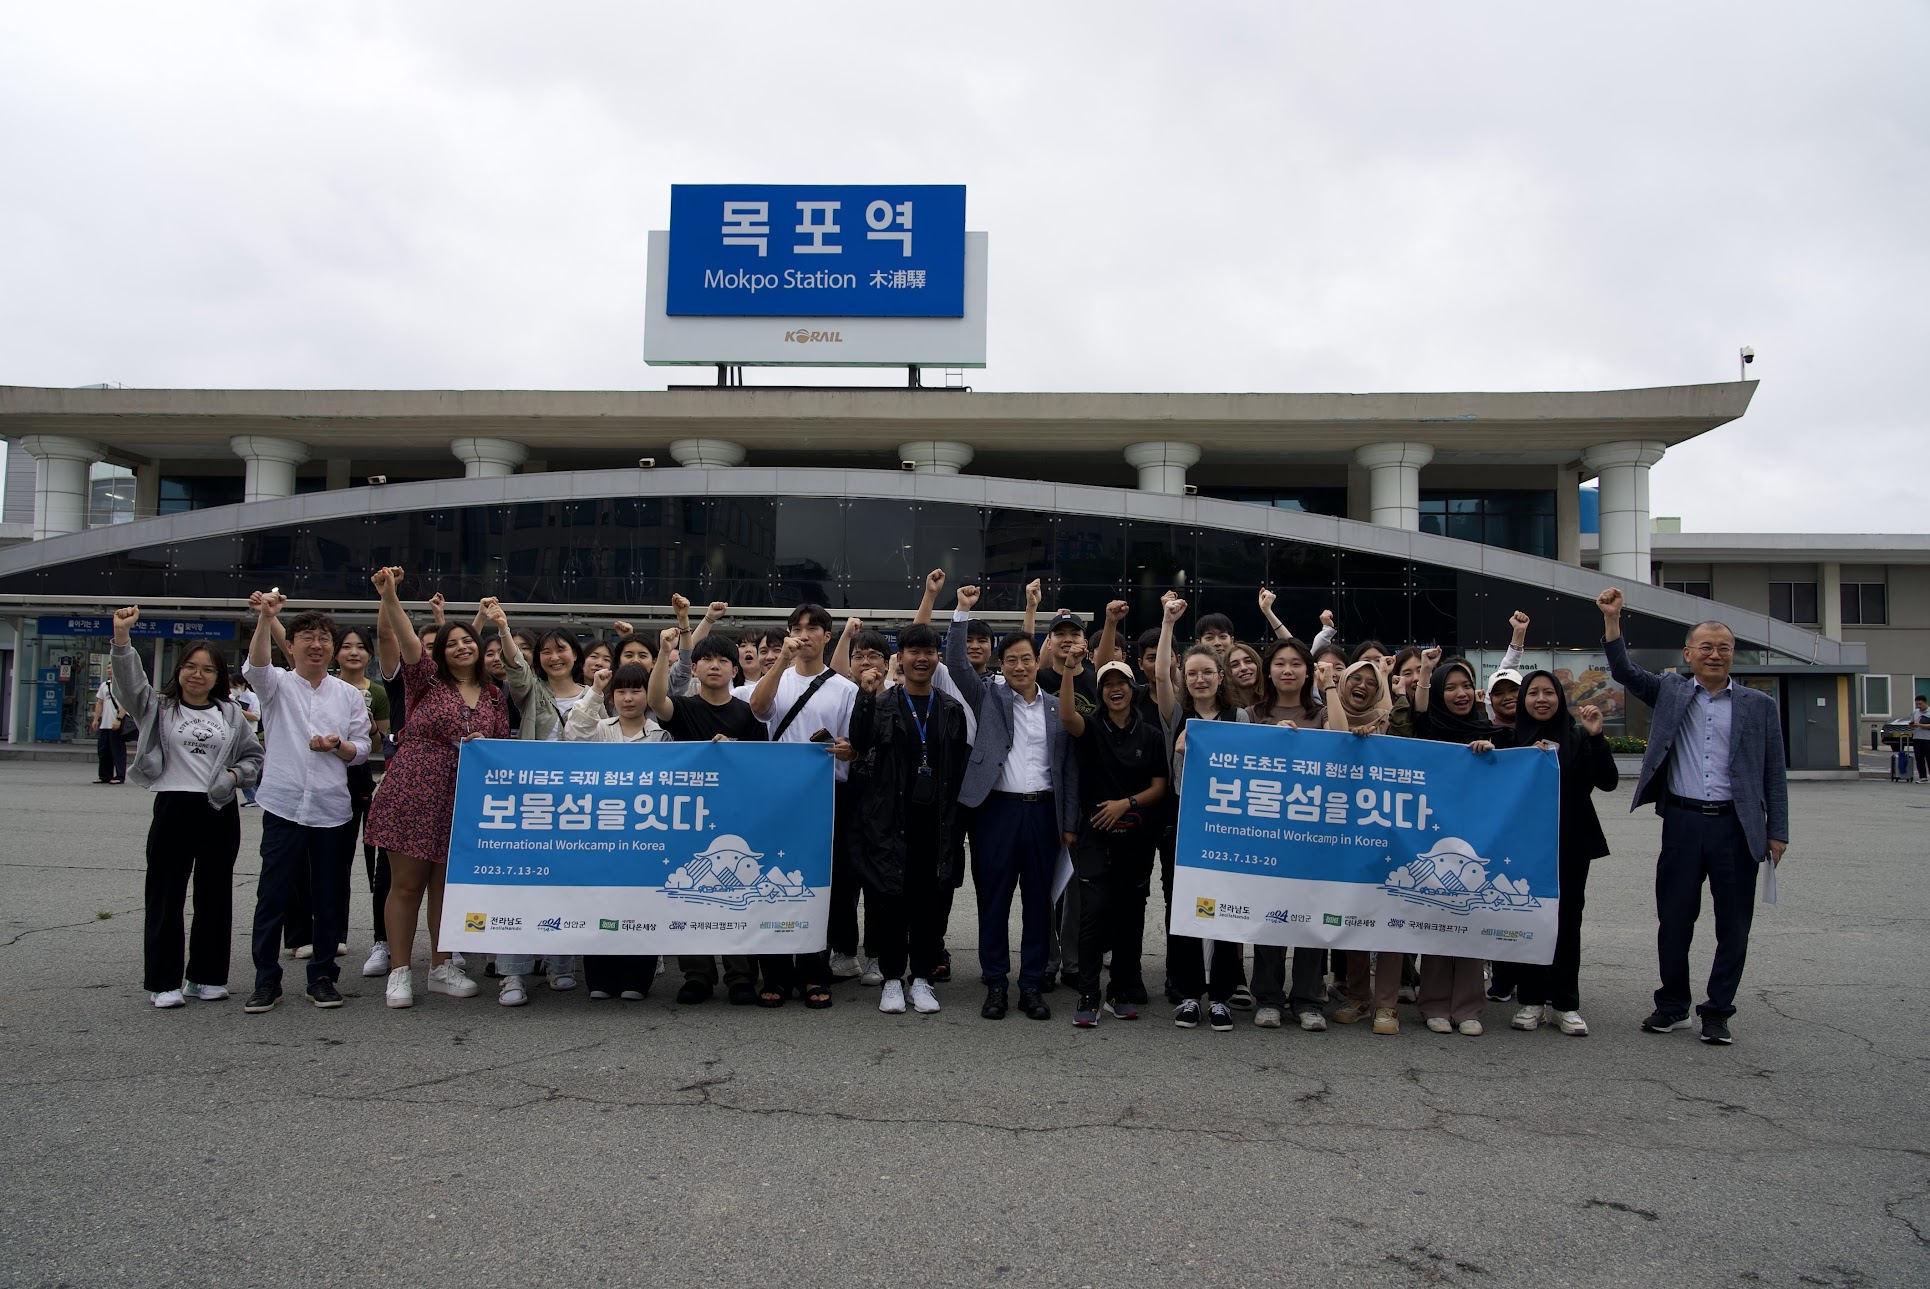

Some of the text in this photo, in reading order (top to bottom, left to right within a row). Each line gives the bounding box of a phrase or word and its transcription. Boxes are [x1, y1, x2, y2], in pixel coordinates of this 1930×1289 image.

[704, 269, 778, 294] Mokpo
[784, 269, 856, 289] Station
[784, 329, 843, 344] KORAIL
[1209, 752, 1426, 785] 신안 도초도 국제 청년 섬 워크캠프
[485, 769, 720, 787] 신안 비금도 국제 청년 섬 워크캠프
[1204, 821, 1388, 848] International Workcamp in Korea
[477, 839, 666, 852] International Workcamp in Korea
[1201, 849, 1277, 866] 2023.7.13-20
[473, 865, 550, 876] 2023.7.13-20
[1219, 903, 1250, 914] 전라남도
[490, 917, 522, 926] 전라남도
[1290, 914, 1311, 922] 신안군
[563, 921, 586, 929] 신안군
[690, 921, 748, 931] 국제워크캠프기구
